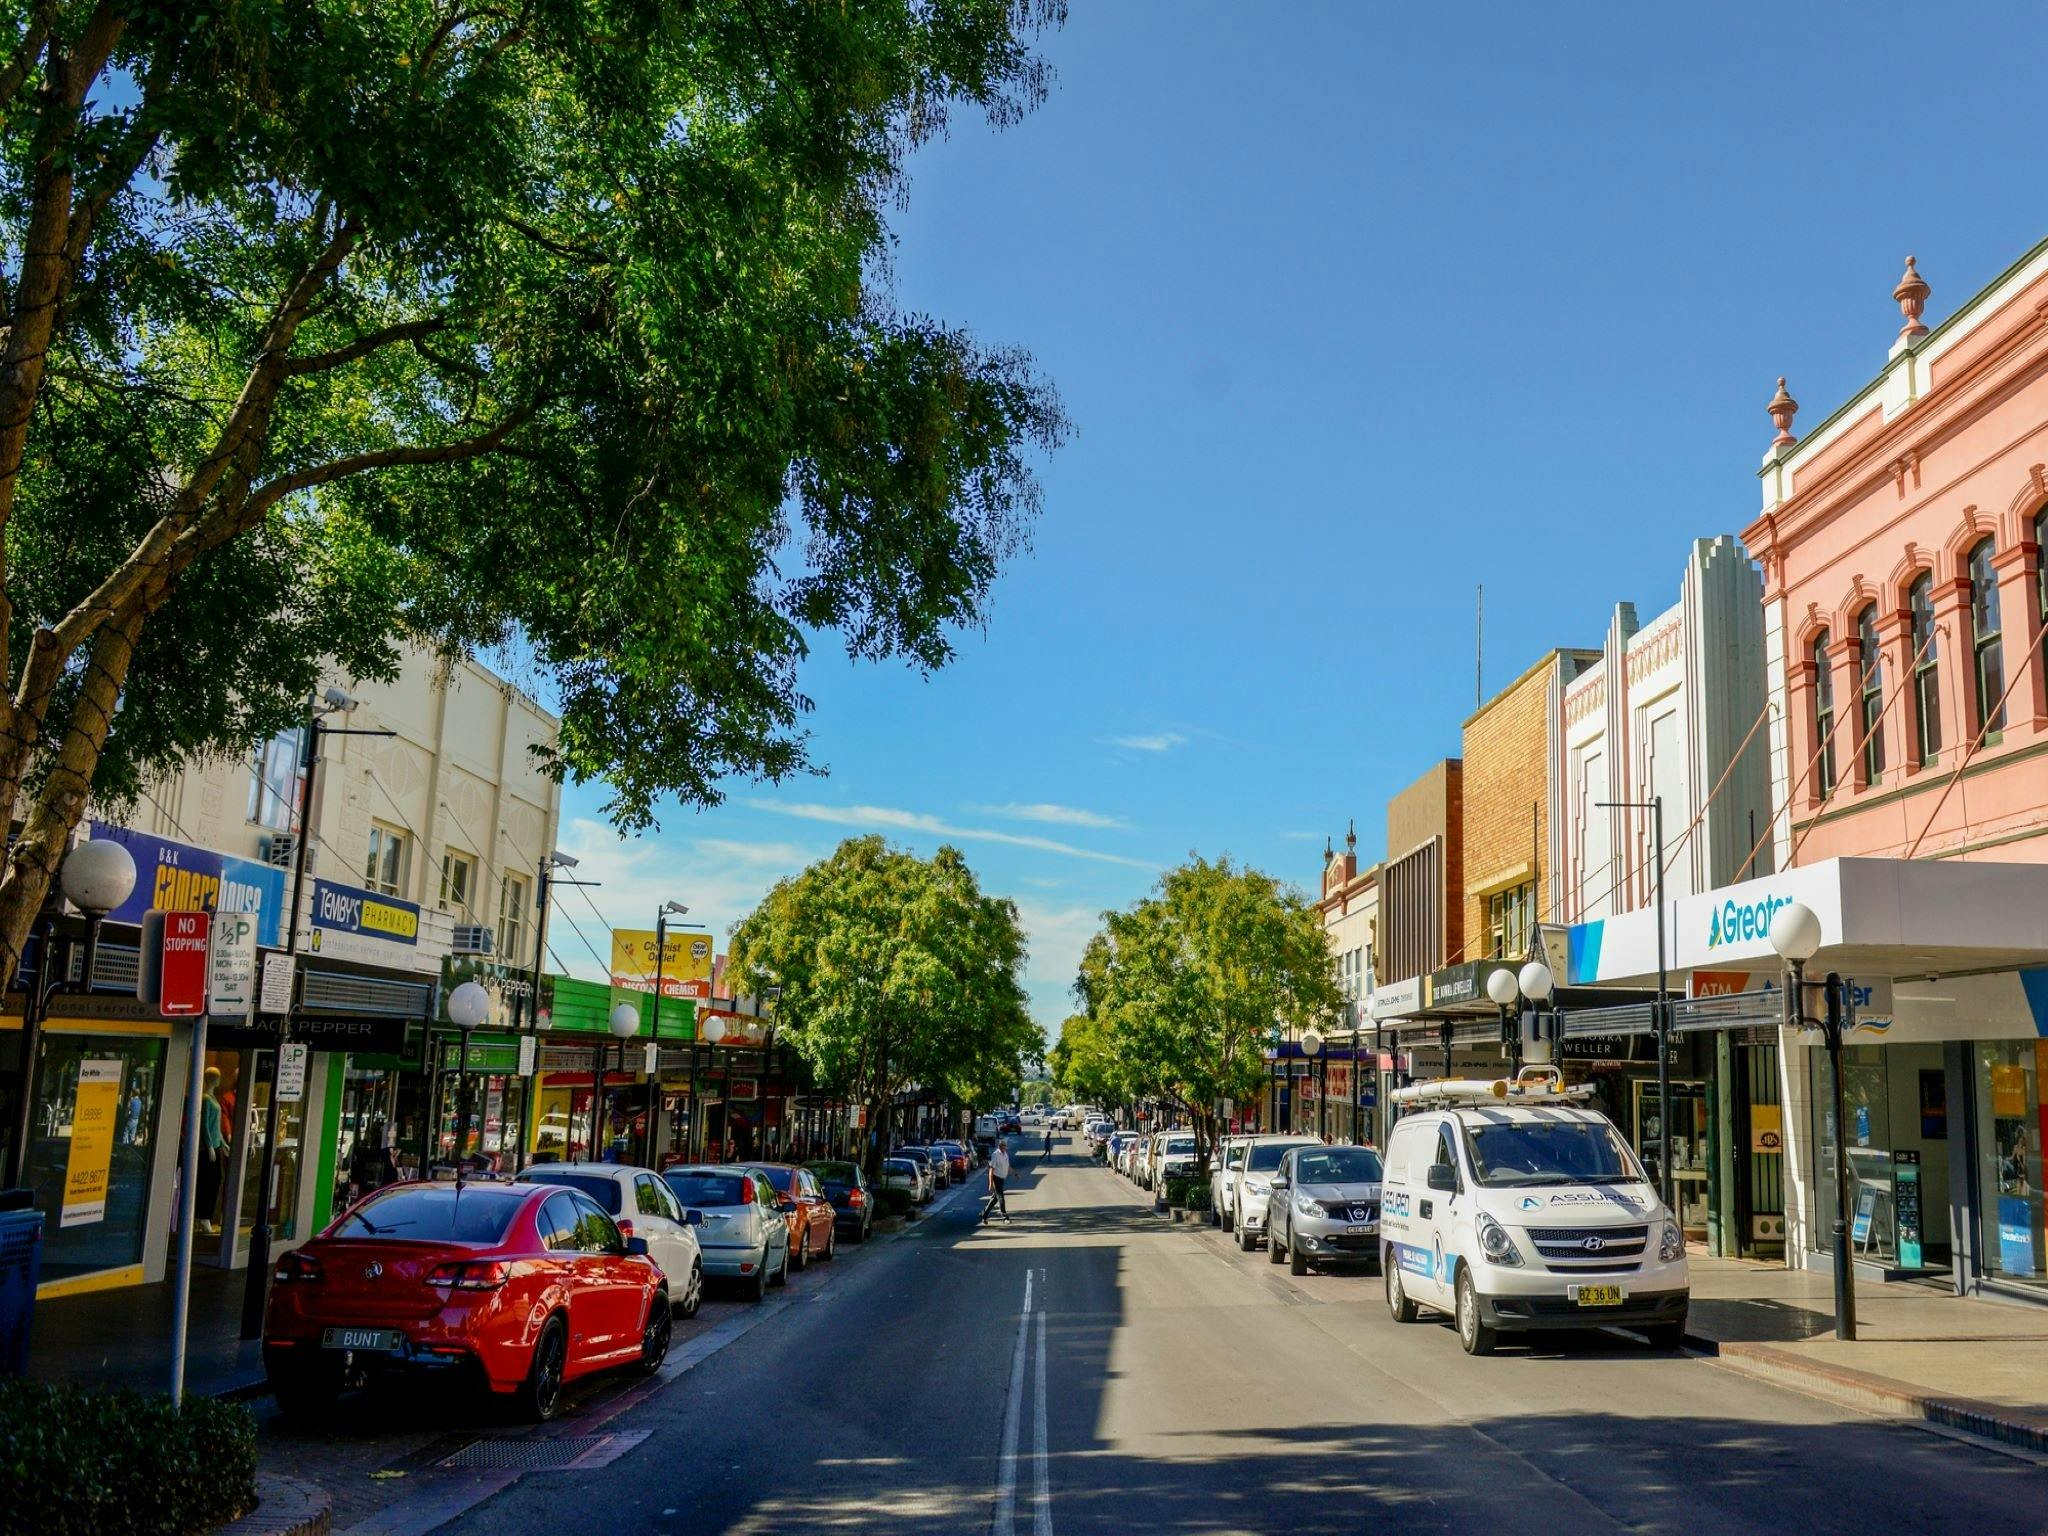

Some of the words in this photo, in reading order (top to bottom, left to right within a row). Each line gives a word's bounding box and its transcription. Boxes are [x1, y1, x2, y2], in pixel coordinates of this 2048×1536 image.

[159, 847, 164, 862] B
[165, 849, 172, 864] &
[173, 851, 178, 865] K
[153, 864, 219, 912] camera
[217, 869, 262, 914] house
[320, 888, 361, 931] TEMBY'S
[364, 905, 415, 932] PHARMACY
[178, 918, 196, 934] NO
[1723, 894, 1793, 944] Great
[165, 937, 206, 952] STOPPING
[643, 941, 681, 953] Chmist
[216, 960, 232, 968] MON
[648, 952, 675, 963] Oulet
[224, 983, 237, 993] SAT
[501, 979, 531, 998] PEPPER
[664, 983, 699, 996] CHEMIST
[1700, 982, 1732, 997] ATM
[299, 1021, 372, 1035] PEPPER
[1564, 1043, 1611, 1054] WELLER
[1550, 1193, 1645, 1204] ASSURED
[343, 1331, 381, 1348] BUNT
